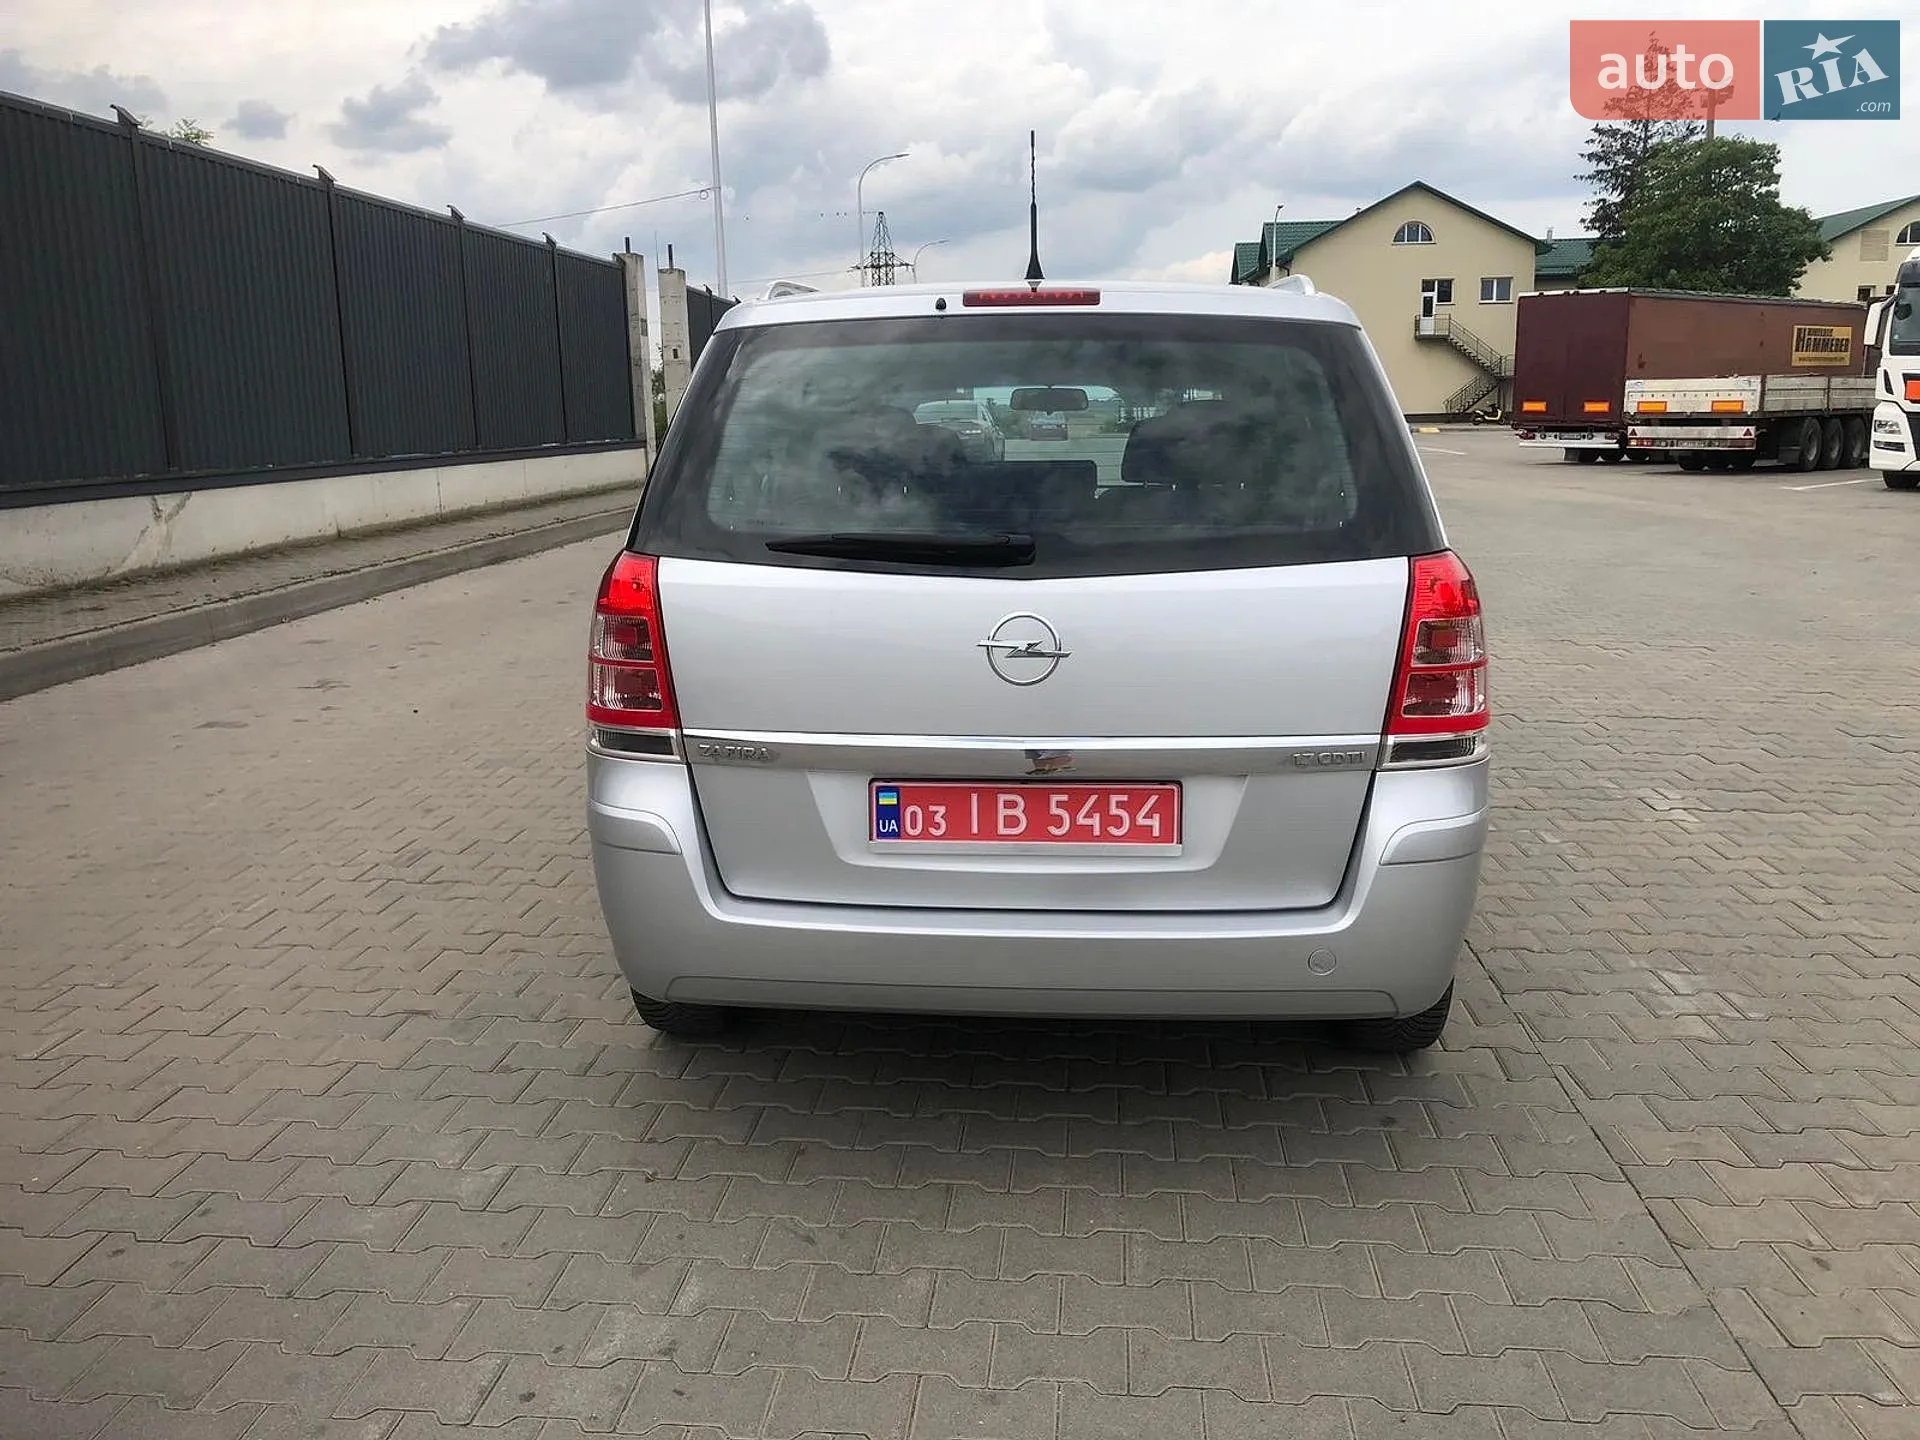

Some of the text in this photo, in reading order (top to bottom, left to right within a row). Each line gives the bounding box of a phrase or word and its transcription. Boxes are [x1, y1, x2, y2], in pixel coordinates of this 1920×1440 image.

[879, 819, 899, 833] UA
[904, 804, 947, 837] 03
[1046, 793, 1161, 838] 5454
